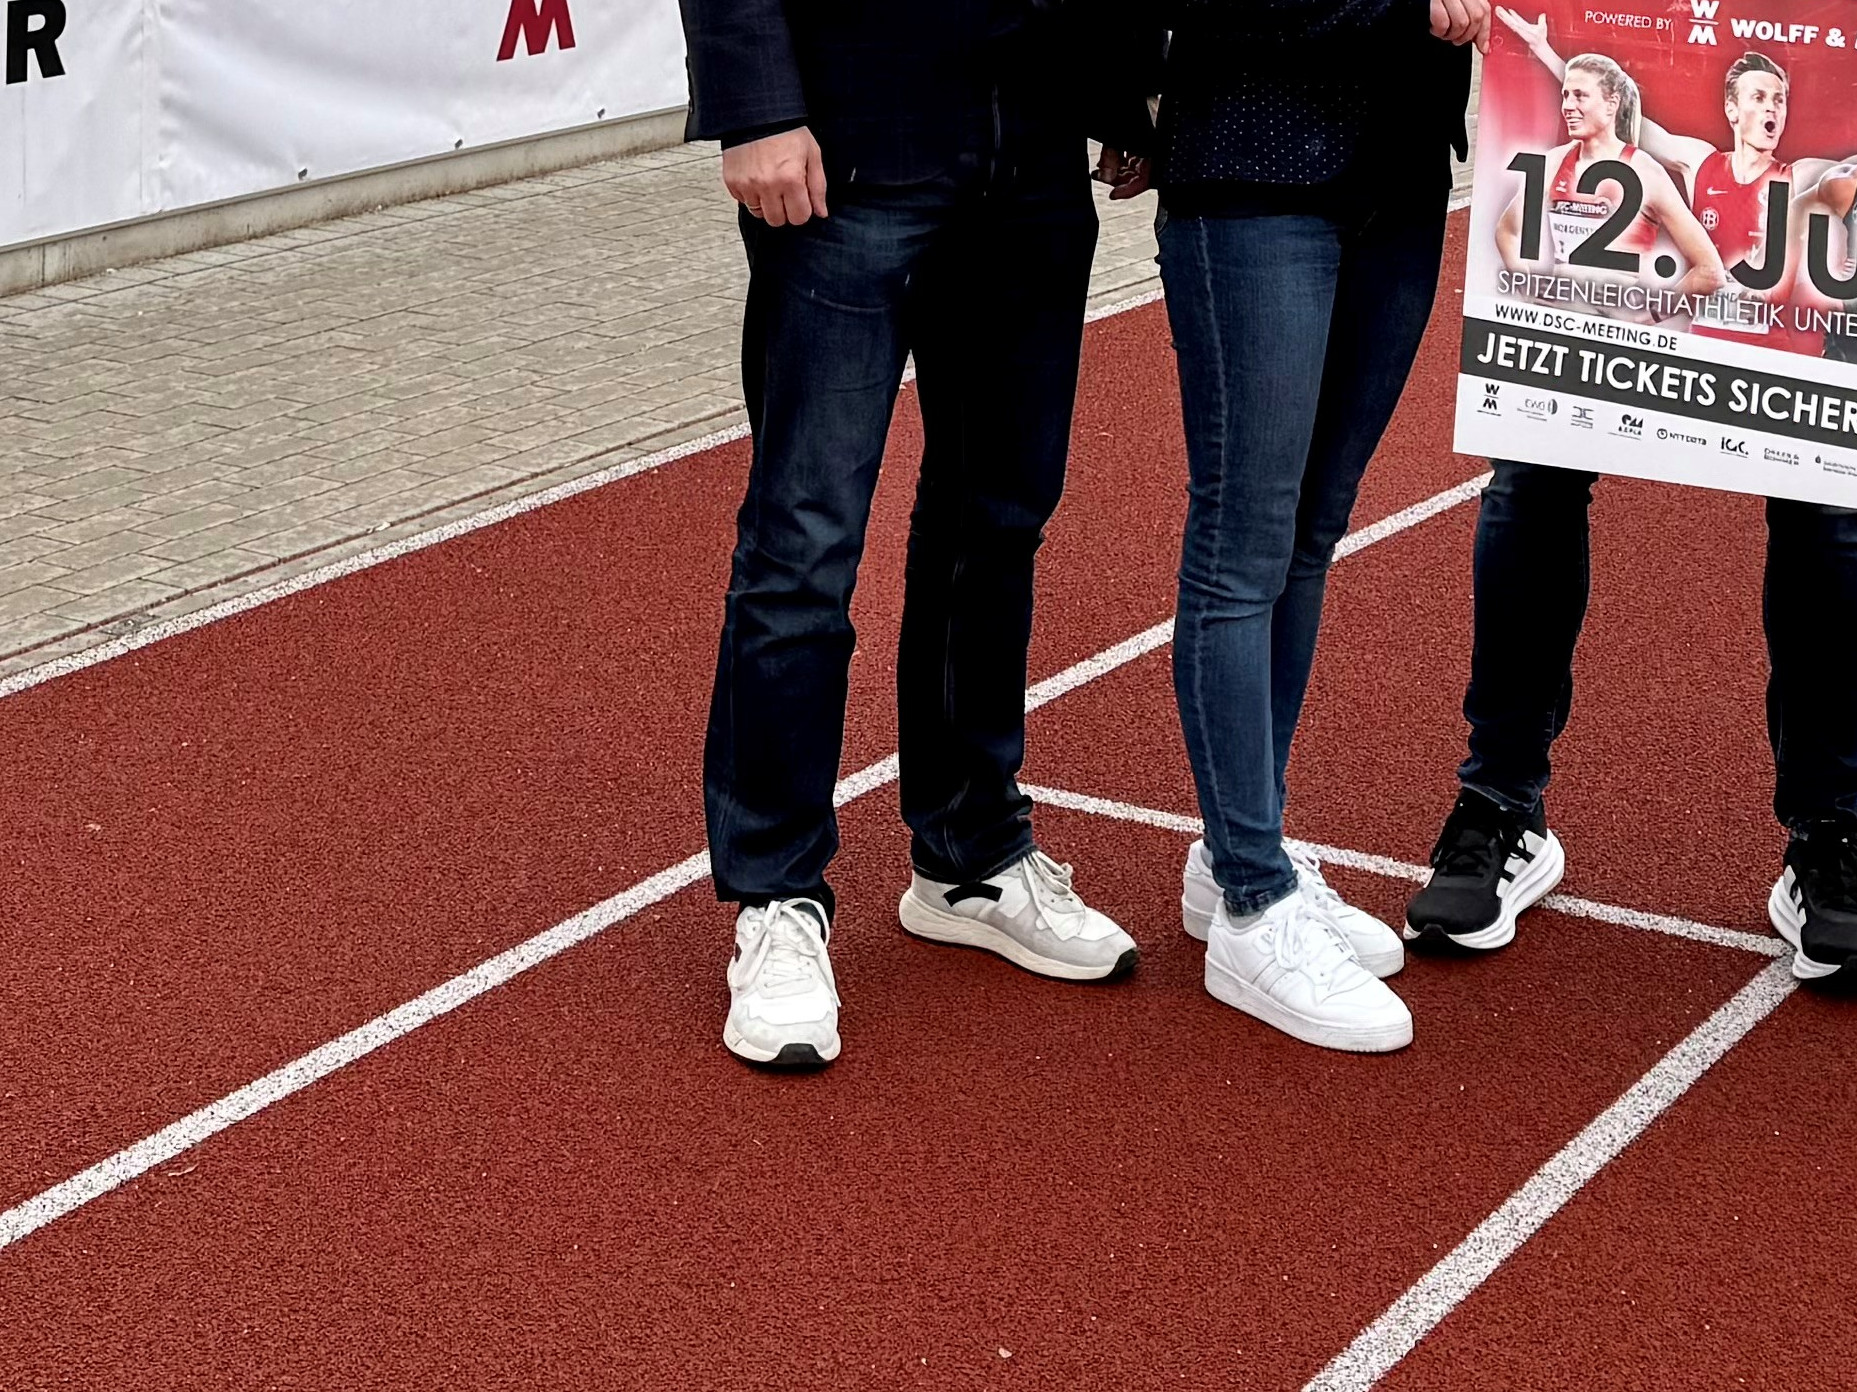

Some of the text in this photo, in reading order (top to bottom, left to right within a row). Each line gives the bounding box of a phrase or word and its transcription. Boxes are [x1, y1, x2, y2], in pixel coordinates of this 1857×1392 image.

[1584, 10, 1672, 30] POWERED BY
[1731, 18, 1818, 44] WOLFF
[1825, 28, 1846, 48] &
[1506, 152, 1677, 278] 12.
[1498, 270, 1784, 328] SPITZENLEICHTATHLETIK
[1495, 304, 1678, 351] WWW.DSC-MEETING.DE
[1477, 332, 1569, 377] JETZT
[1578, 350, 1718, 407] TICKETS
